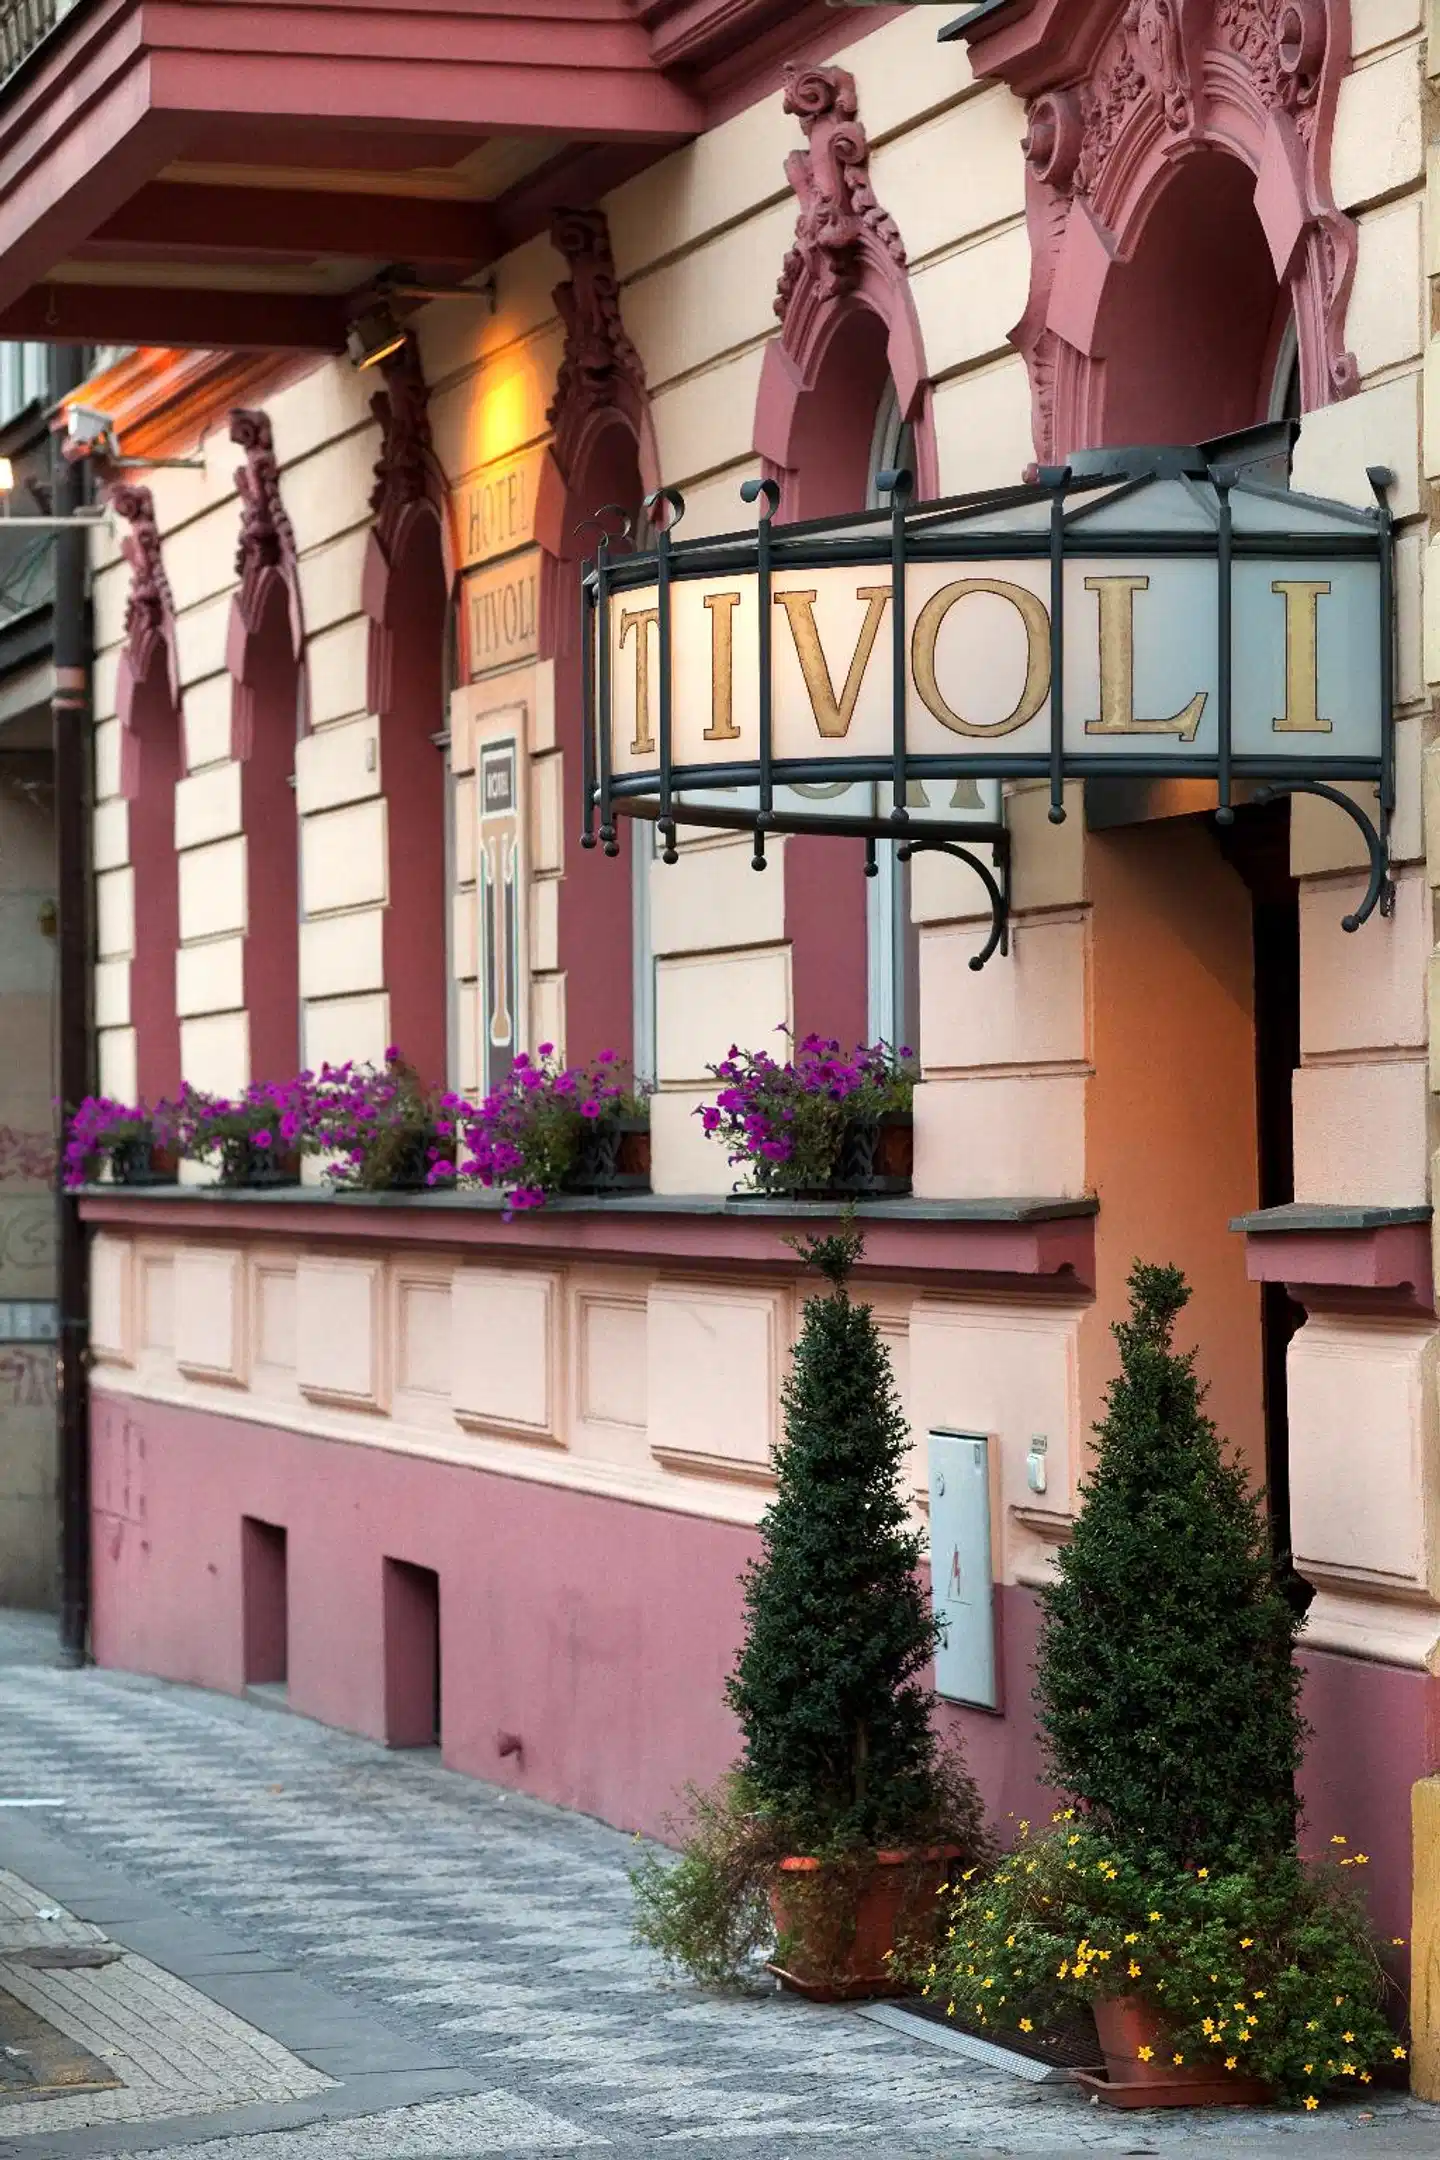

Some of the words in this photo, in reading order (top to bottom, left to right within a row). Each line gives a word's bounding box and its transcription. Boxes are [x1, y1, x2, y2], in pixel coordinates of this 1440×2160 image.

[468, 471, 529, 556] HOTEL
[472, 575, 535, 656] TIVOLI
[619, 575, 1332, 755] TIVOLI
